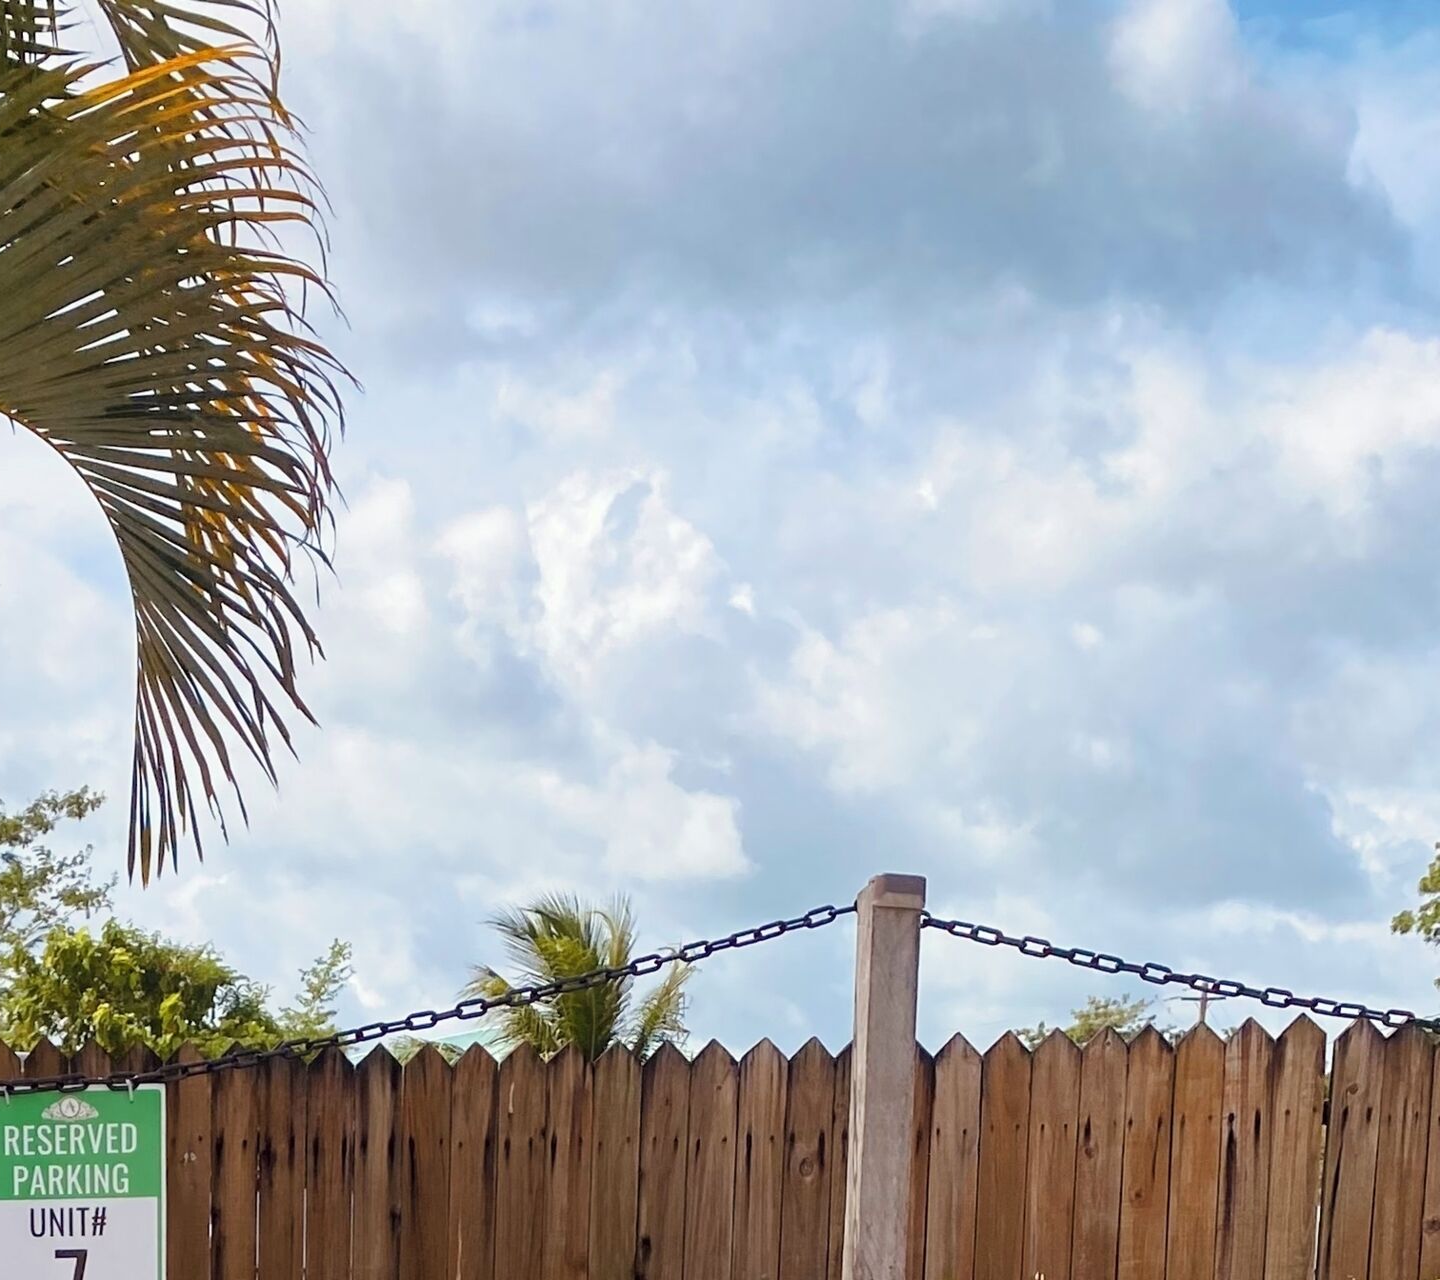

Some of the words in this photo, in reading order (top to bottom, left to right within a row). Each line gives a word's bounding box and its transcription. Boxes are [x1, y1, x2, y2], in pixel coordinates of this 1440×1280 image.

[4, 1123, 137, 1156] RESERVED
[13, 1163, 129, 1196] PARKING
[30, 1207, 107, 1238] UNIT#
